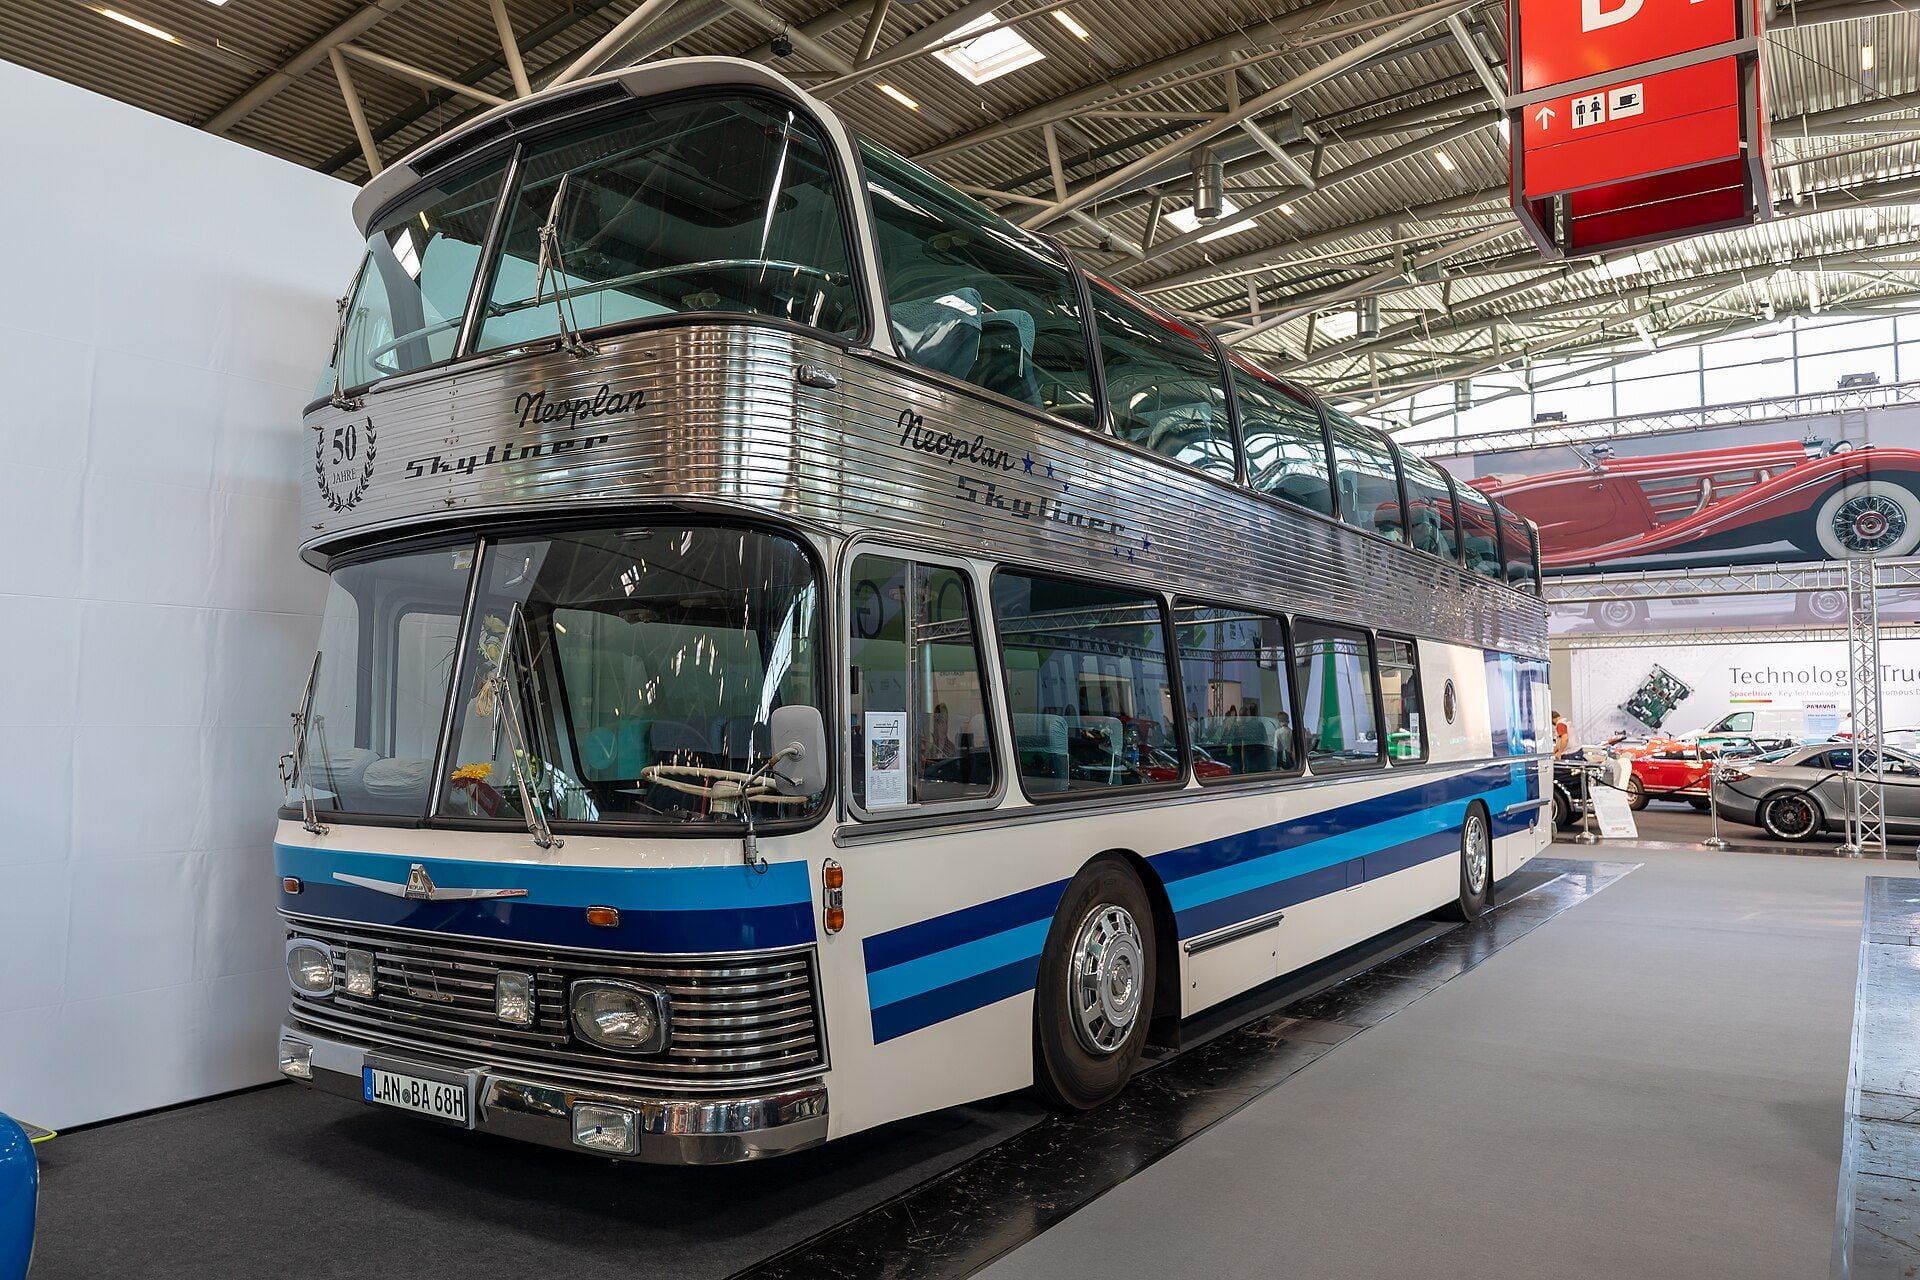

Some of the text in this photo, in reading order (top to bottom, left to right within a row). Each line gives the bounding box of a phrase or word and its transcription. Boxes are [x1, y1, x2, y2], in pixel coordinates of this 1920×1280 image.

[515, 384, 646, 430] Neoplan
[333, 425, 357, 465] 50
[405, 435, 609, 480] Skyliner
[898, 408, 1016, 471] Neoplan
[332, 468, 357, 484] JAHRE
[956, 476, 1126, 534] Skyliner
[1729, 666, 1870, 687] Technologe
[1729, 690, 1772, 698] SpaceDrive
[373, 1072, 463, 1117] LAN BA 68H
